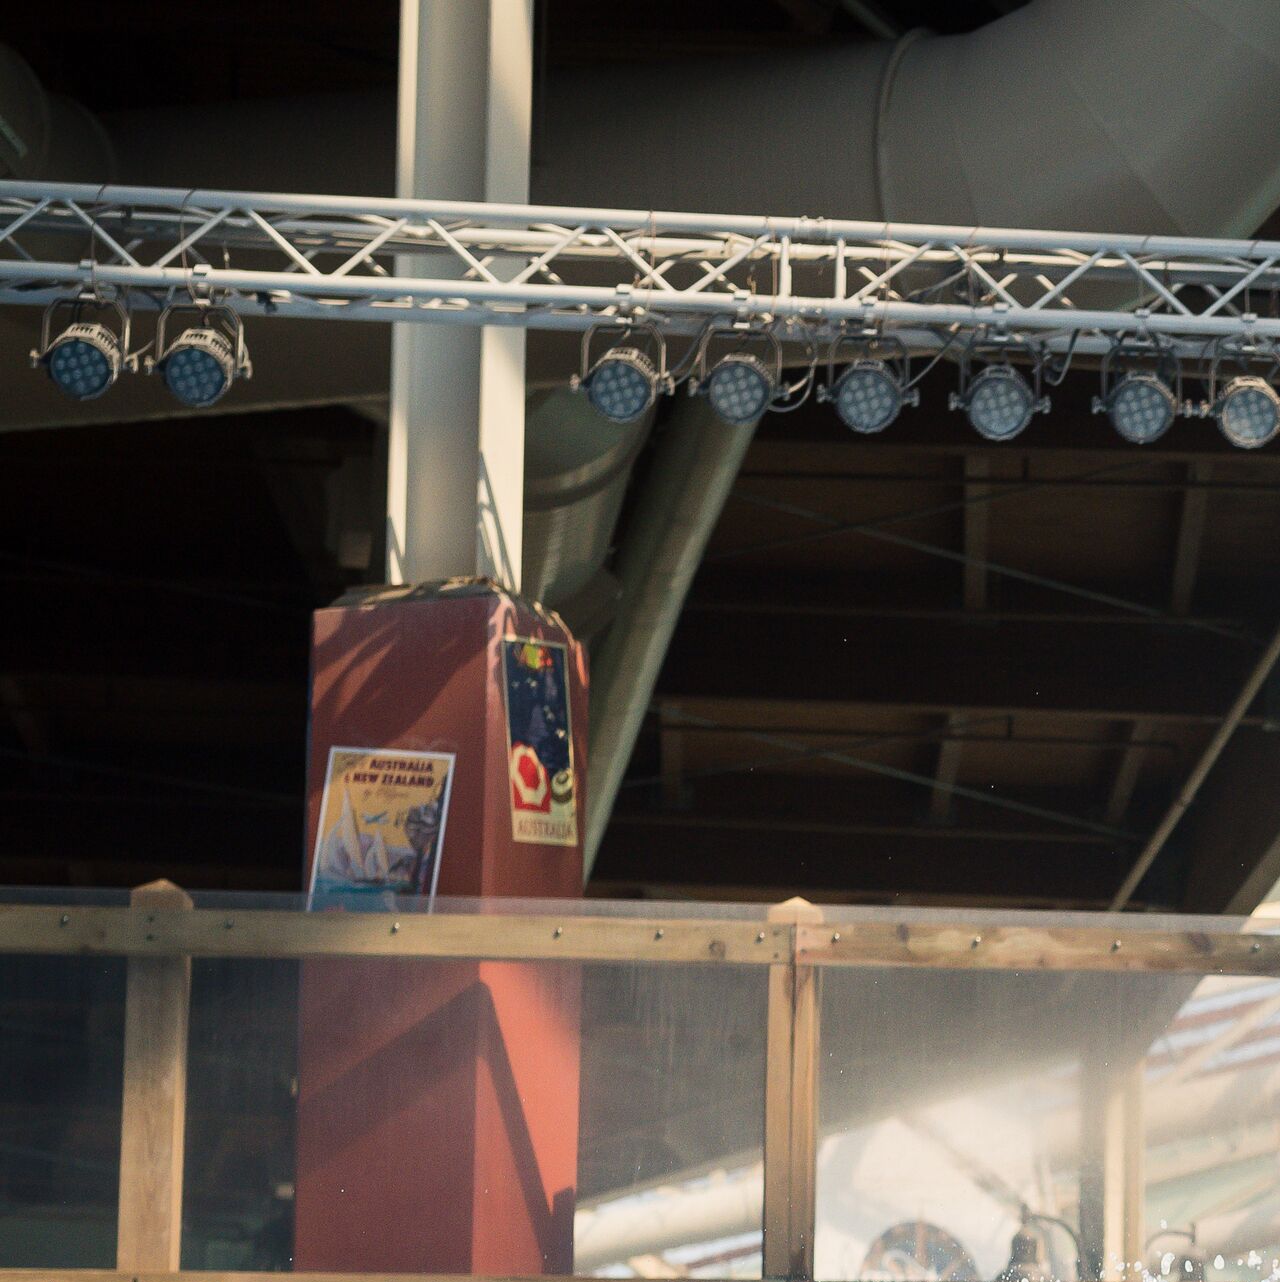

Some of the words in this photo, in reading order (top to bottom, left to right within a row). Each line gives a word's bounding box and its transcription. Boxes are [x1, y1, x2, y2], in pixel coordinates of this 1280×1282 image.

[370, 759, 433, 773] AUSTRALIA
[353, 772, 379, 783] NEW
[382, 773, 434, 787] ZEALAND
[517, 820, 575, 839] AUSTRALIA
